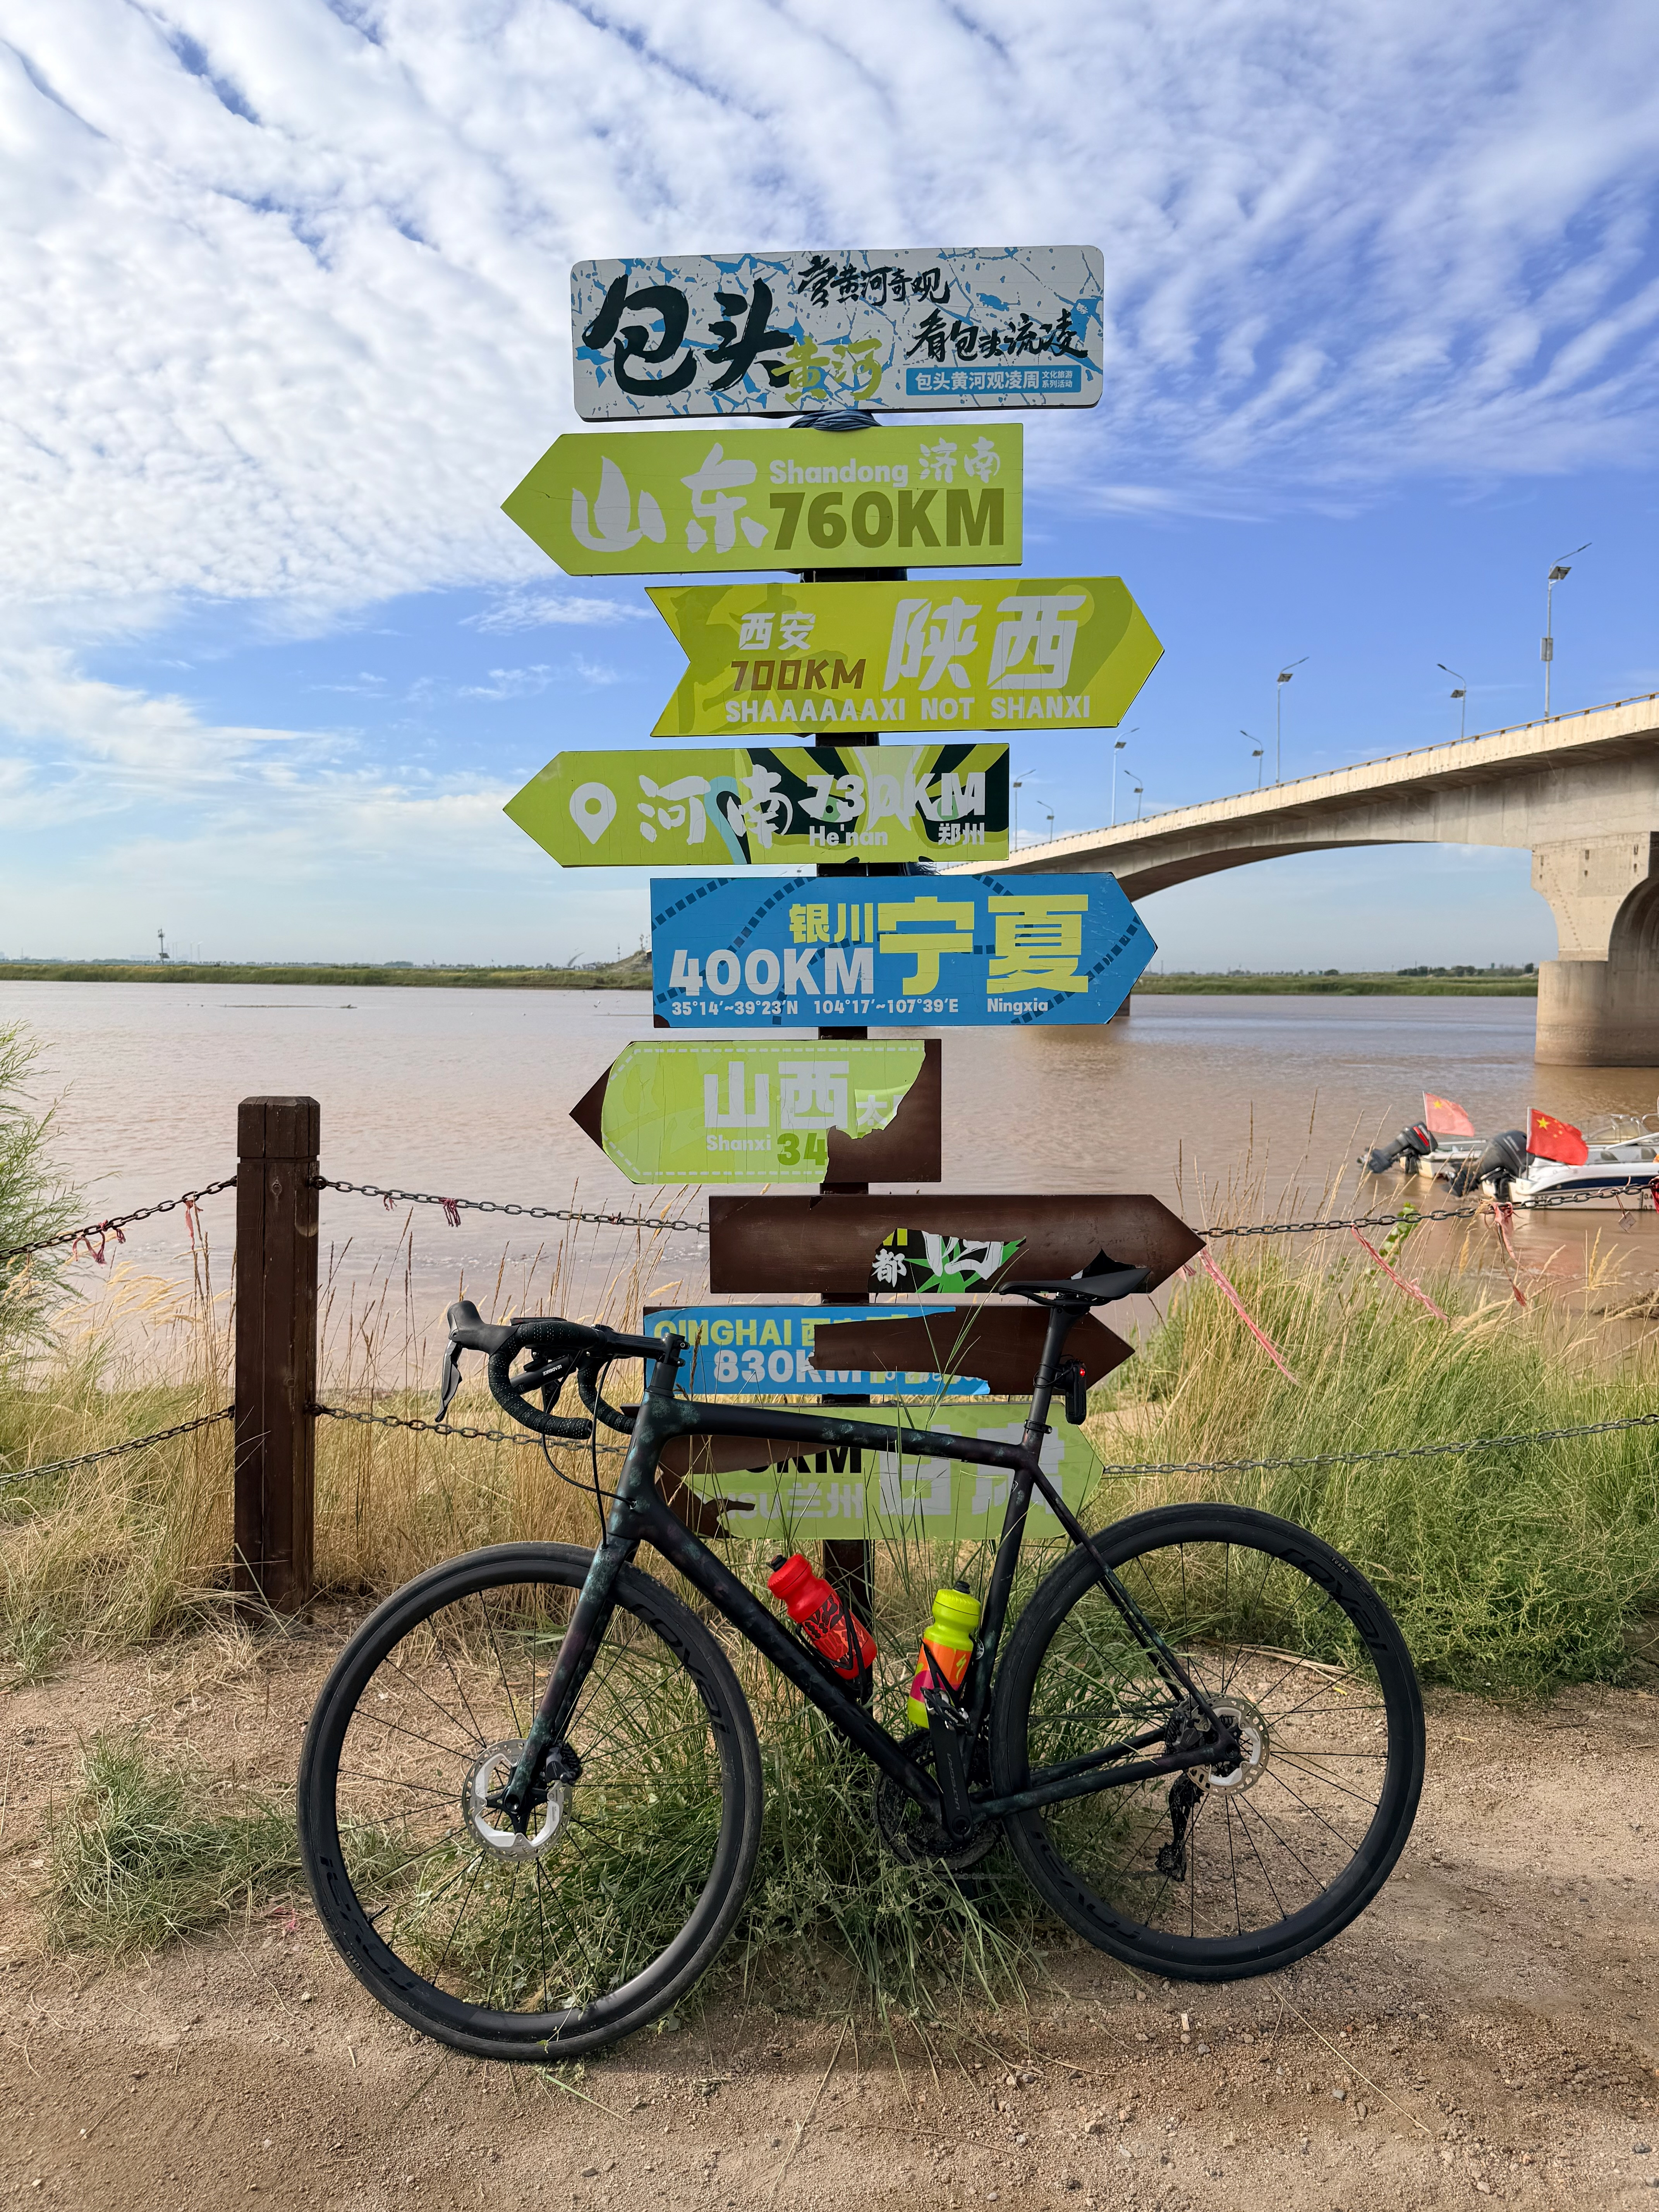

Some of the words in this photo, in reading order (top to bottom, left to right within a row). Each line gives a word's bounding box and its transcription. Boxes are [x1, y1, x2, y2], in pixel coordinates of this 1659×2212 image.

[582, 273, 795, 397] 包头
[906, 308, 1088, 362] 看包头流凌
[772, 336, 882, 404] 黄河
[915, 371, 1039, 390] 包头黄河观凌周
[1041, 370, 1073, 379] 文化旅游
[1042, 380, 1072, 388] 系列活动
[769, 459, 909, 488] Shandong
[919, 436, 1001, 484] 济南
[571, 442, 769, 554] 山东
[769, 488, 1005, 550] 760KM
[739, 611, 816, 651] 西安
[883, 595, 1087, 692] 陕西
[731, 658, 867, 691] 700KM
[725, 698, 905, 722] SHAAAAAAXI
[921, 697, 973, 720] NOT
[991, 695, 1090, 719] SHANXI
[637, 763, 793, 848] 河南
[807, 772, 986, 818] 730KM
[809, 824, 888, 846] He'nan
[938, 823, 985, 845] 郑州
[789, 903, 873, 944] 银川
[878, 895, 1089, 995] 宁夏
[668, 947, 874, 997] 400KM
[988, 997, 1048, 1014] Ningxia
[704, 1061, 849, 1130] 山西
[706, 1134, 771, 1152] Shanxi
[787, 1482, 863, 1518] 兰州
[1331, 1558, 1349, 1573] TURBO
[346, 1951, 362, 1971] TURBO
